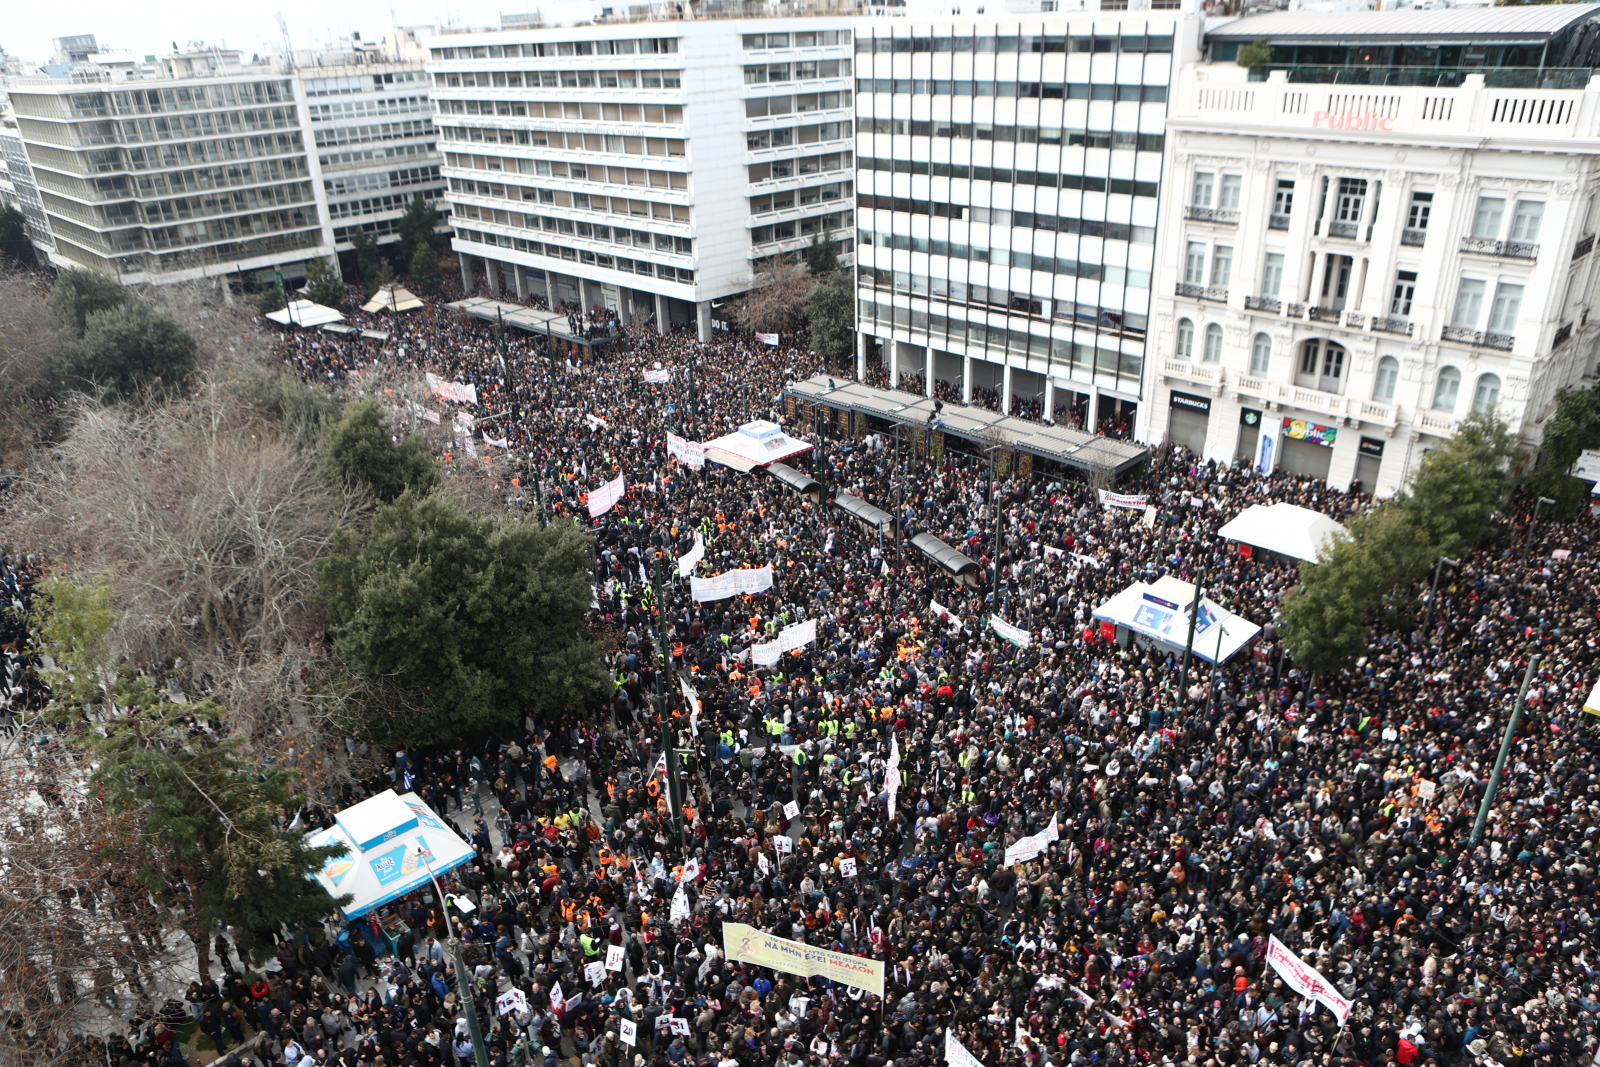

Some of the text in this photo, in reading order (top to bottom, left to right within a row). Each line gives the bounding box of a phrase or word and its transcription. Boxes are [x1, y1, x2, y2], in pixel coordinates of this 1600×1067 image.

[1312, 110, 1394, 131] Public
[711, 319, 720, 329] DO
[1173, 396, 1208, 410] STARBUCKS
[1291, 424, 1326, 440] Public
[843, 862, 854, 873] 57
[611, 952, 620, 963] 41
[764, 940, 779, 951] ΝΑ
[780, 945, 802, 958] ΜΗΝ
[804, 953, 827, 964] ΕΧΕΙ
[829, 959, 875, 976] ΜΕΛΛΟΝ
[843, 956, 868, 967] ΙΣΤΟΡΙΑ
[623, 1024, 633, 1037] 20
